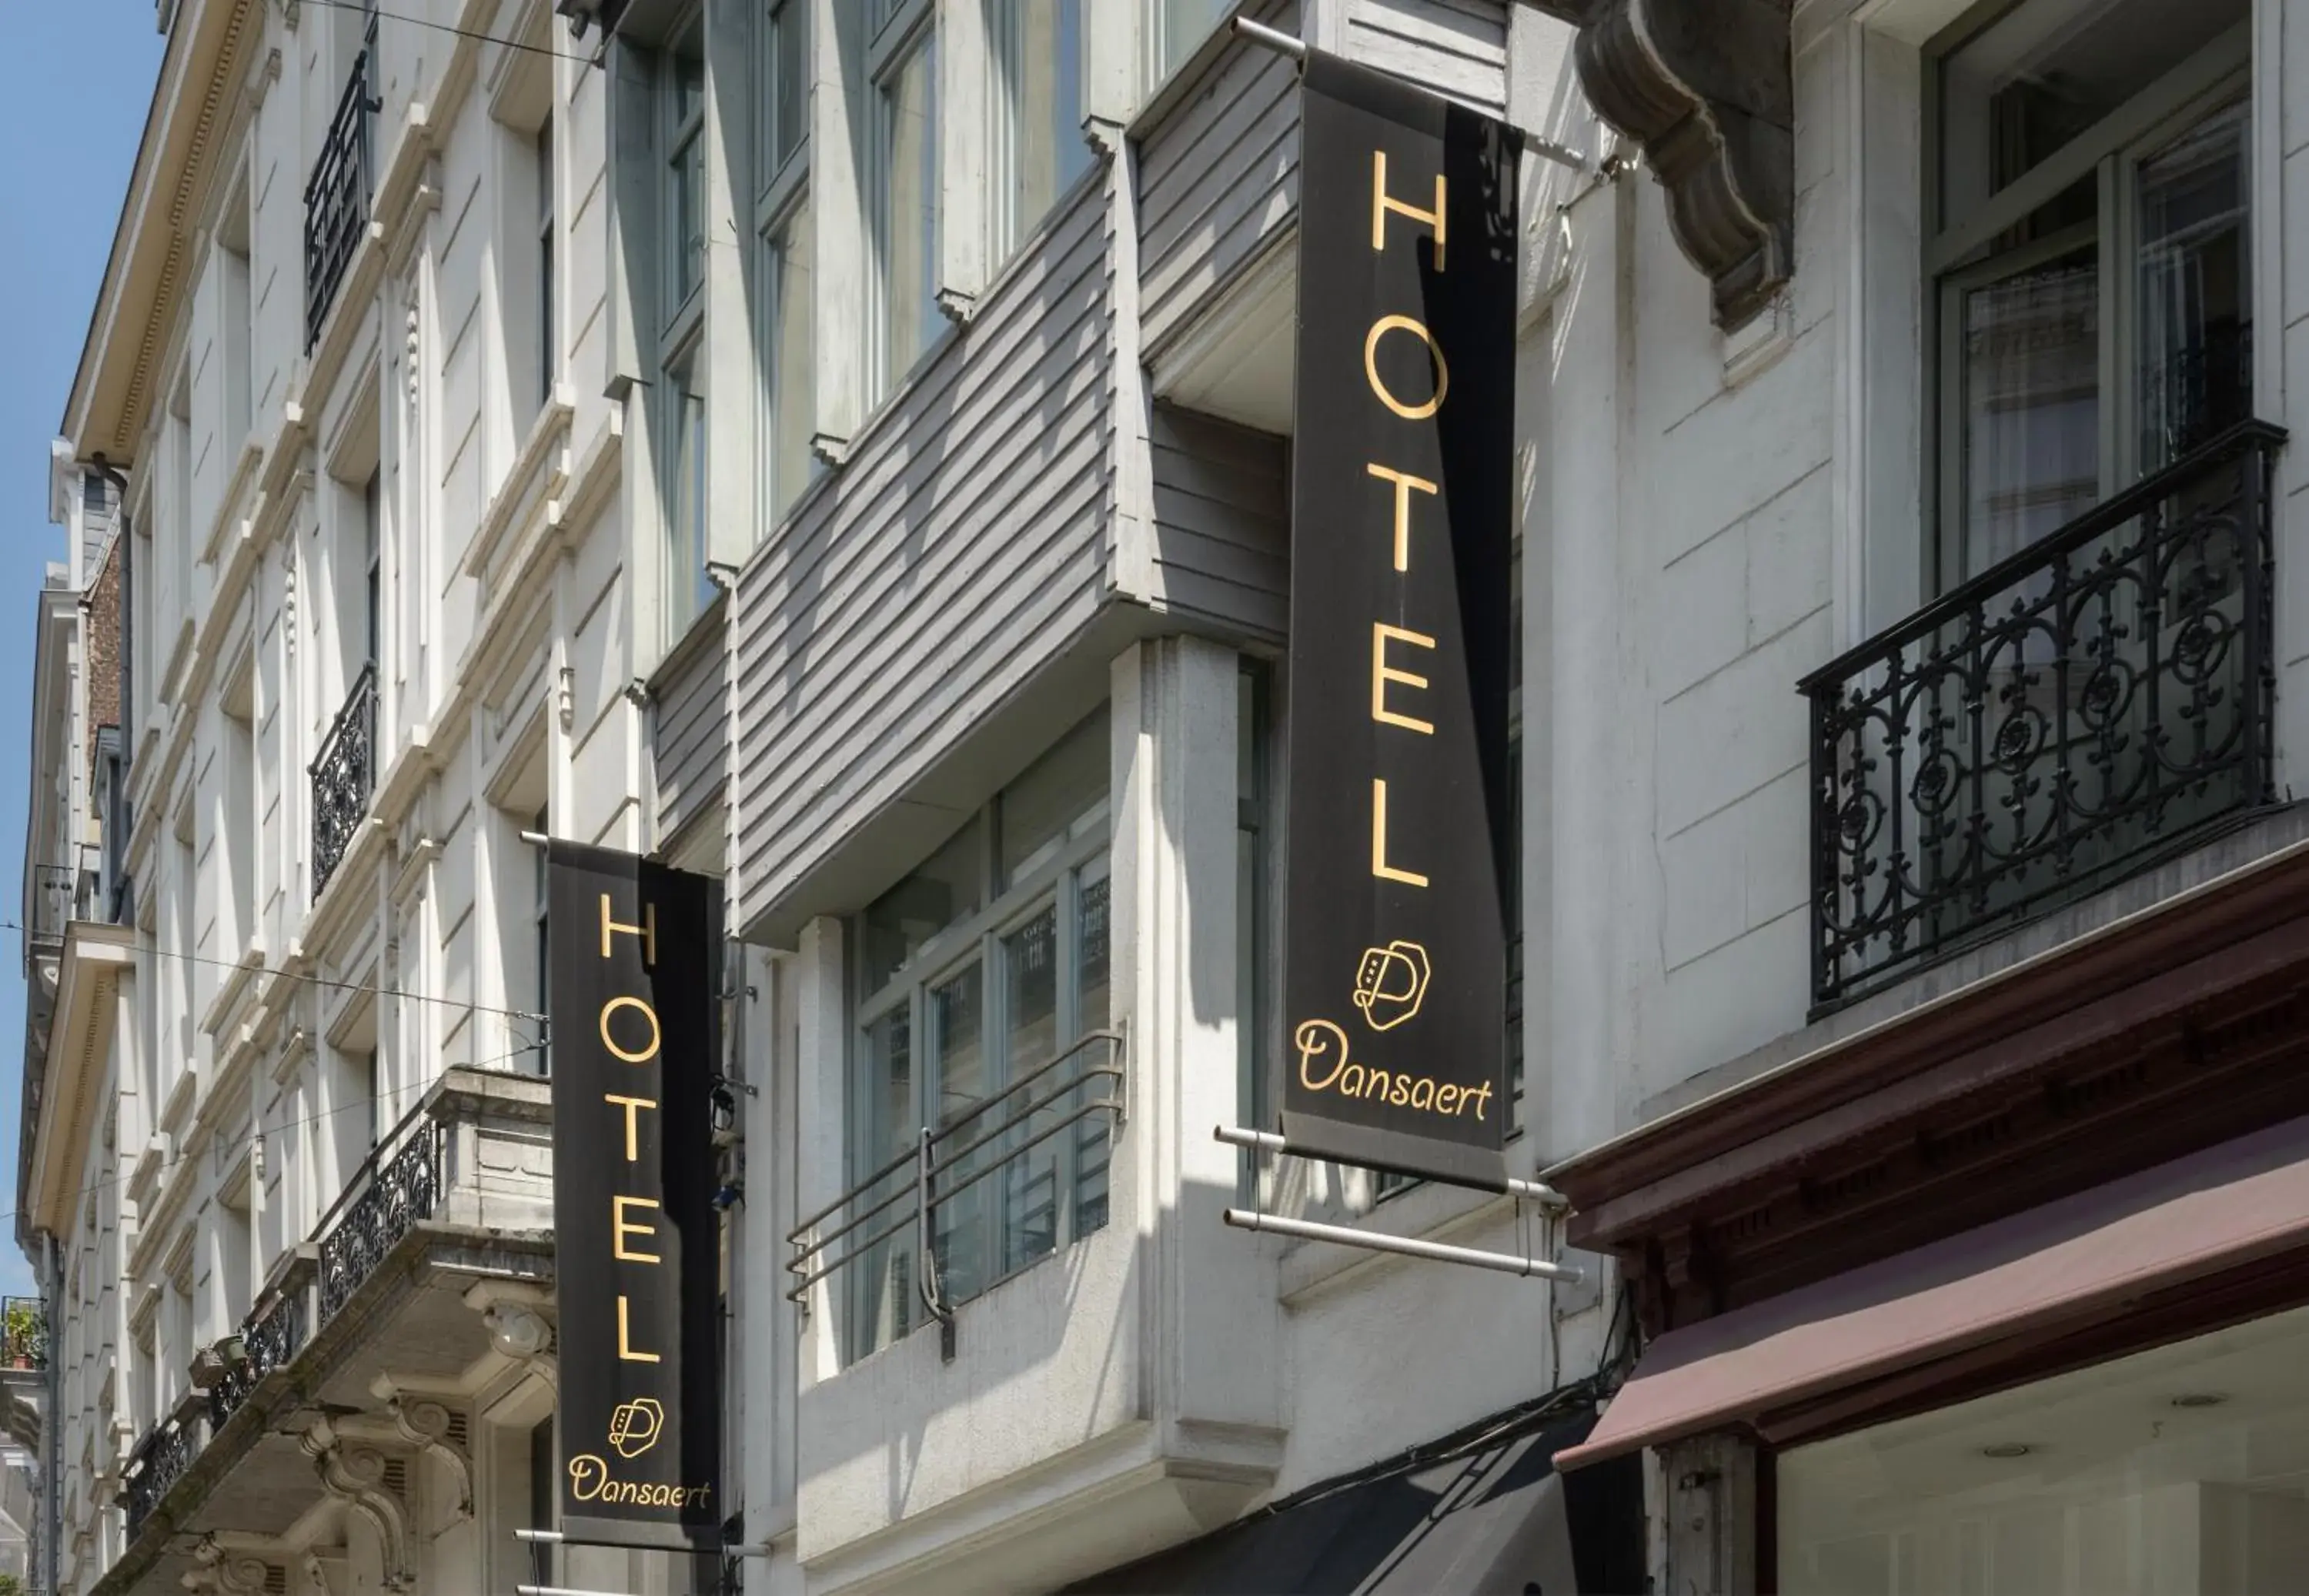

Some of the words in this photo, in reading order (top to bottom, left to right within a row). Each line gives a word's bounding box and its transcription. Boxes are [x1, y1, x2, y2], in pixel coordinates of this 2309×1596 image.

[1365, 149, 1448, 887] HOTEL
[600, 893, 661, 1362] HOTEL
[1295, 1019, 1492, 1120] Dansaert
[569, 1454, 711, 1508] Dansaert
